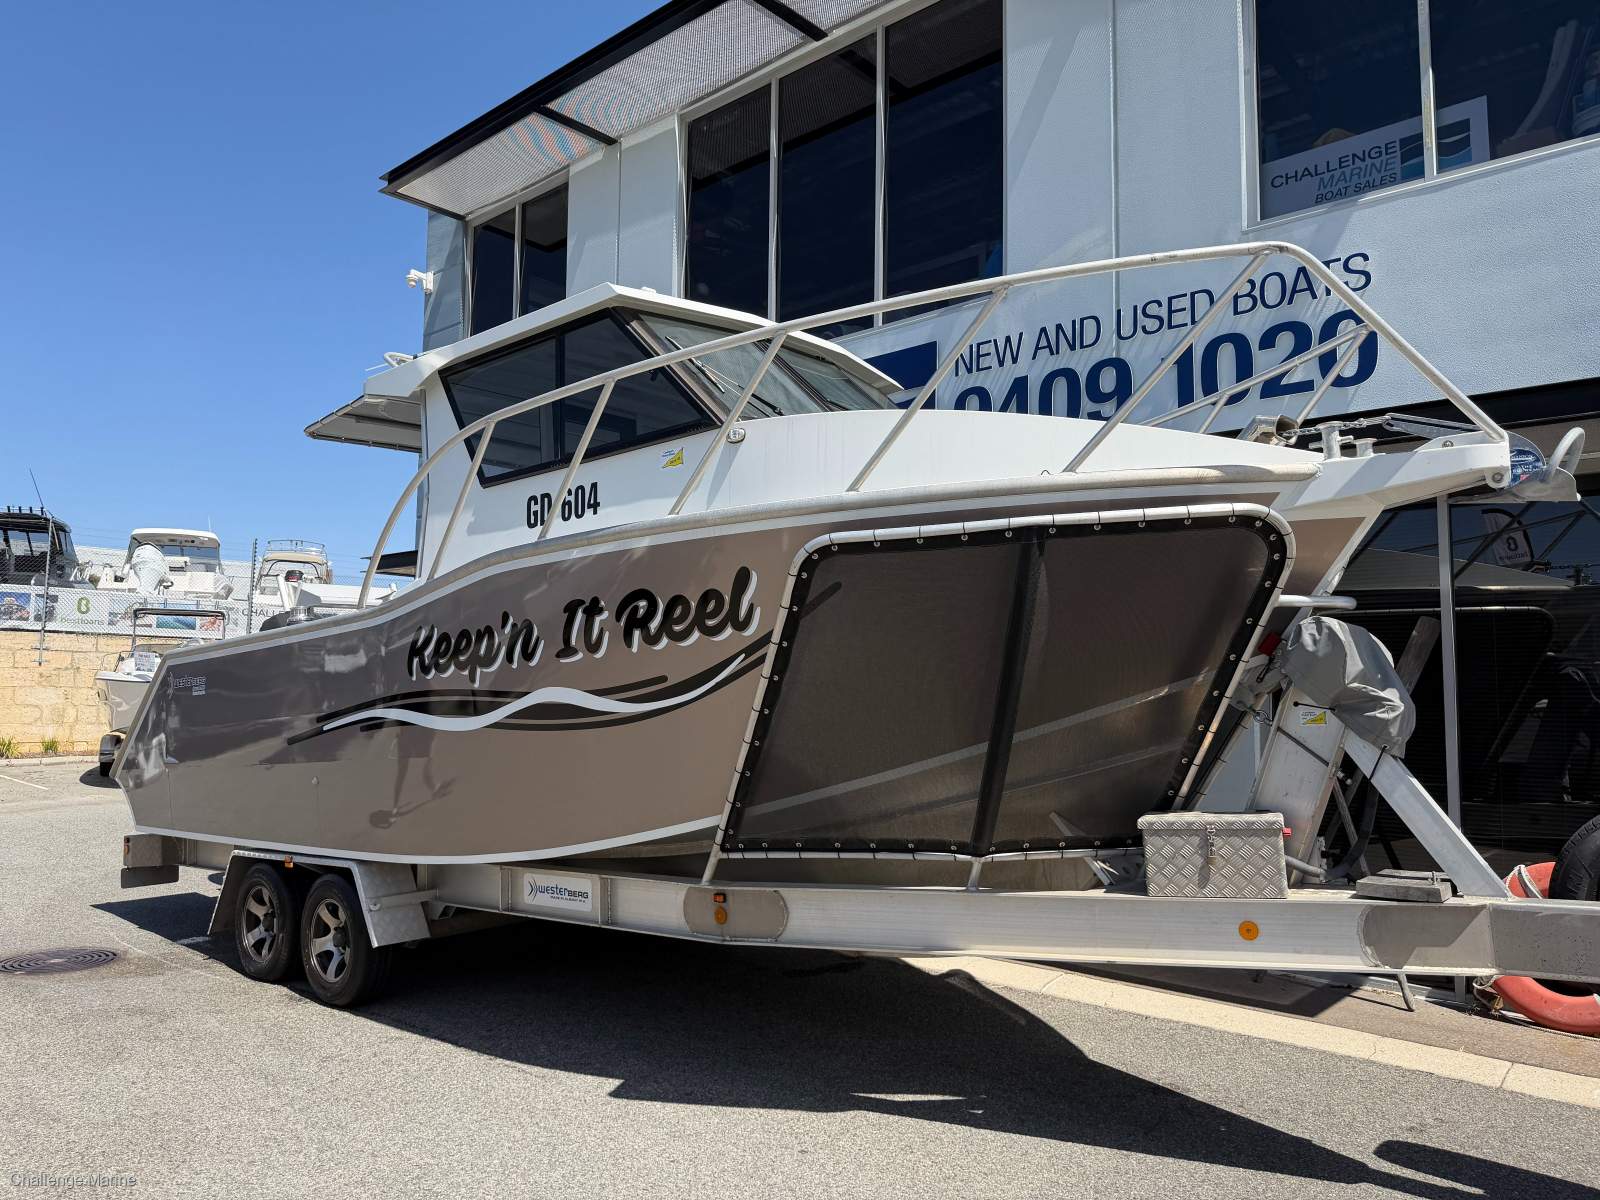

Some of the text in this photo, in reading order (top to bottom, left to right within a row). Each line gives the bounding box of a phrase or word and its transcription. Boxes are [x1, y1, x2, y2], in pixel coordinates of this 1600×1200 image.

[1271, 141, 1397, 188] CHALLENGE
[1314, 173, 1397, 204] BOAT SALES
[1317, 157, 1397, 190] MARINE
[954, 252, 1372, 377] NEW AND USED BOATS
[1160, 309, 1379, 409] 1020
[526, 481, 601, 529] GD 604
[407, 565, 761, 688] Keep'n It Reel
